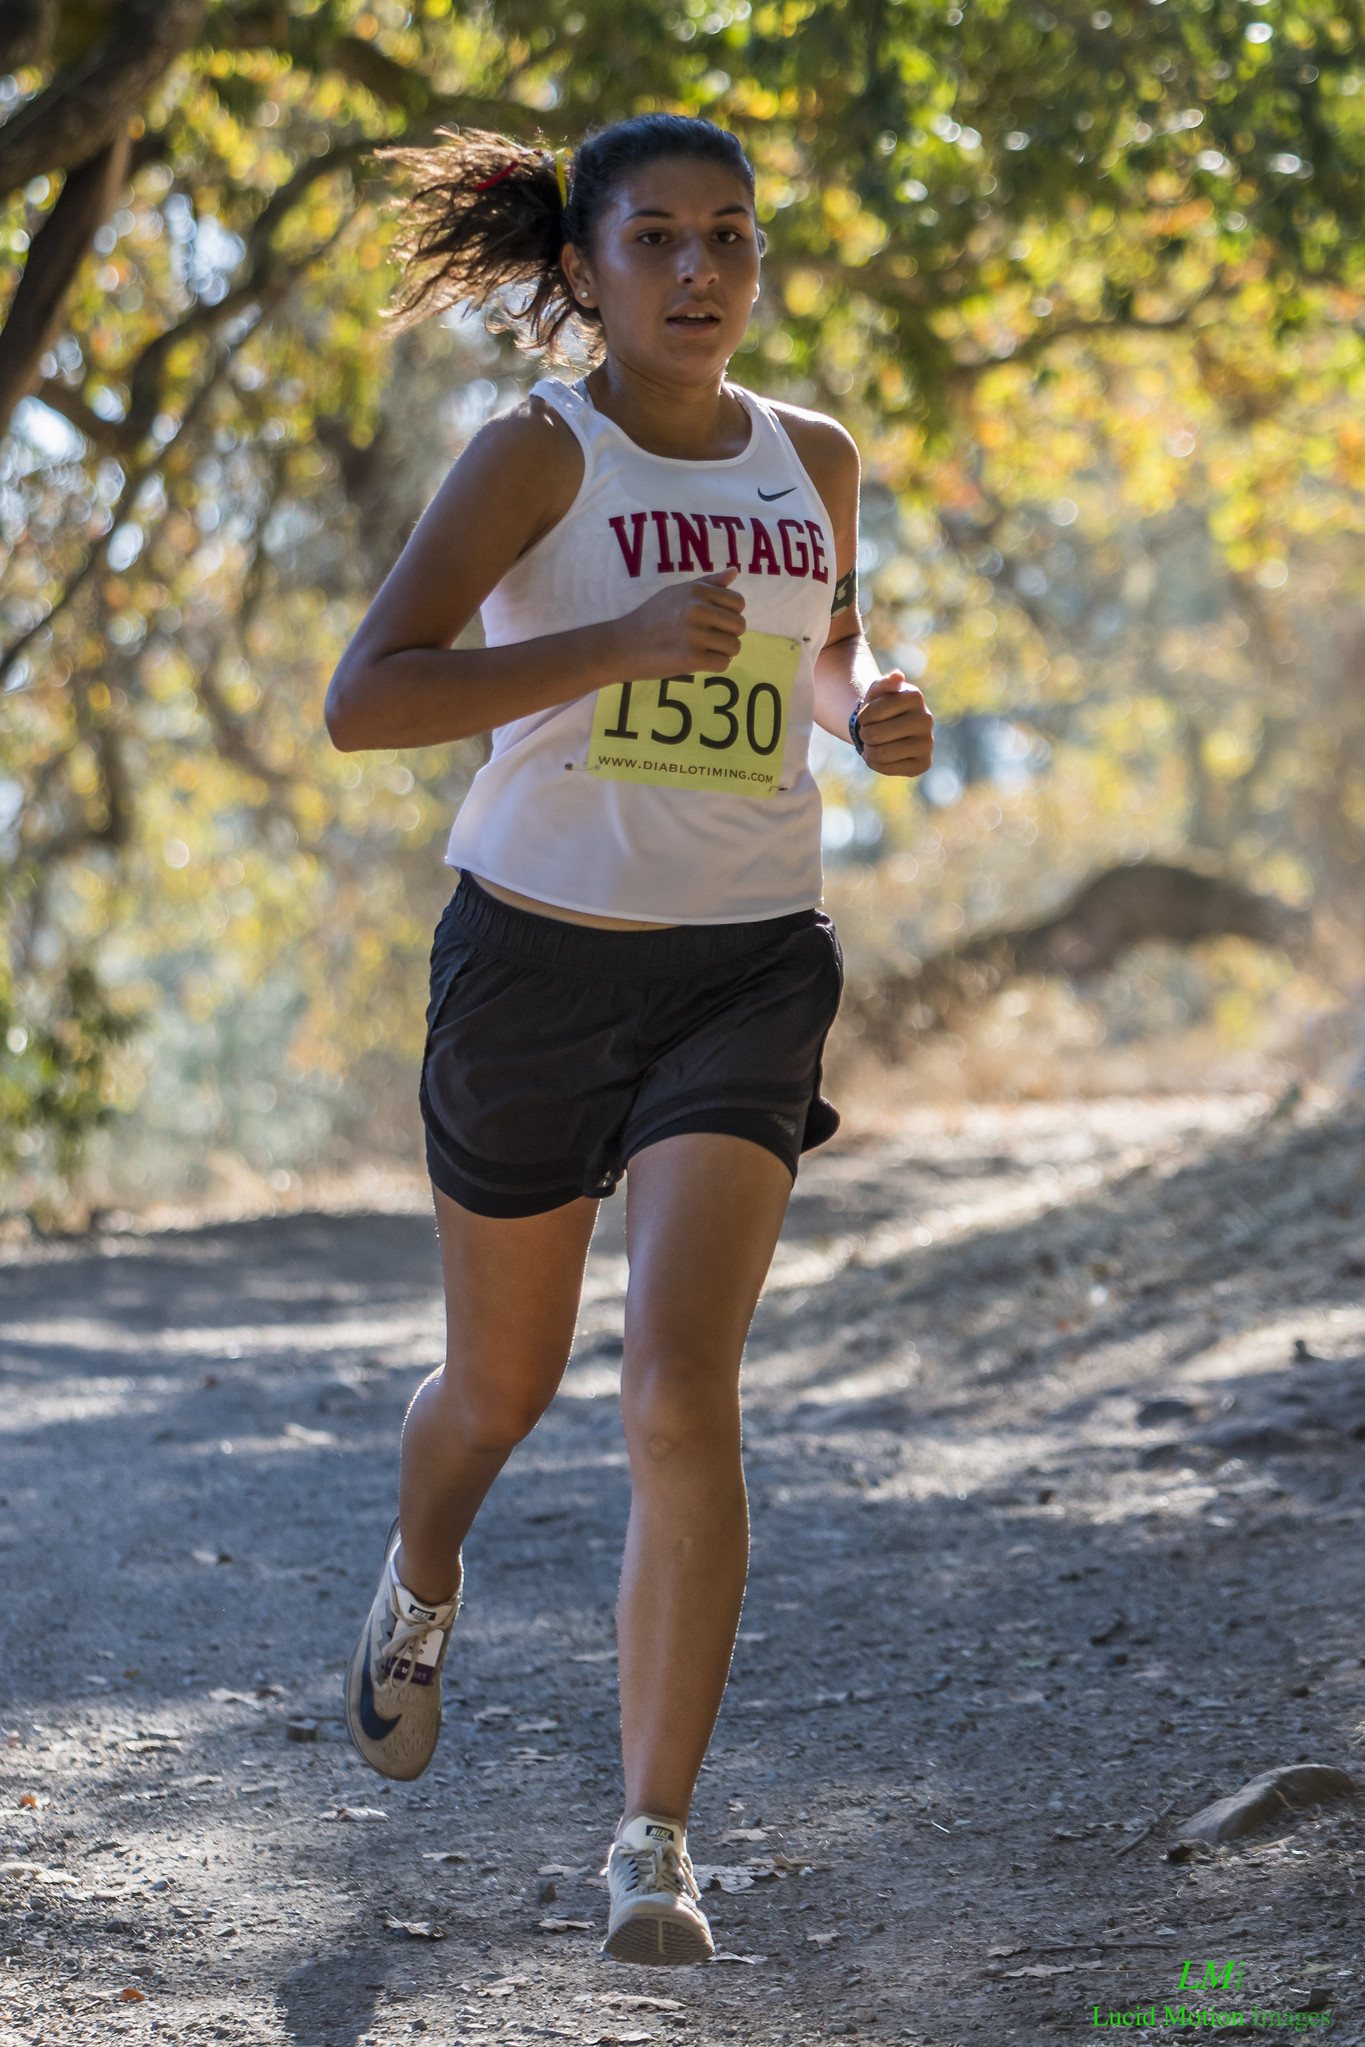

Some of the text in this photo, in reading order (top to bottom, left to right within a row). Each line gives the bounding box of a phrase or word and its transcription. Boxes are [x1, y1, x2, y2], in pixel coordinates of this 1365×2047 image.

[608, 510, 829, 584] VINTAGE
[603, 674, 782, 756] 1530
[598, 756, 773, 783] WWW.DIABLOTIMING.COM
[649, 1827, 671, 1838] NIKE
